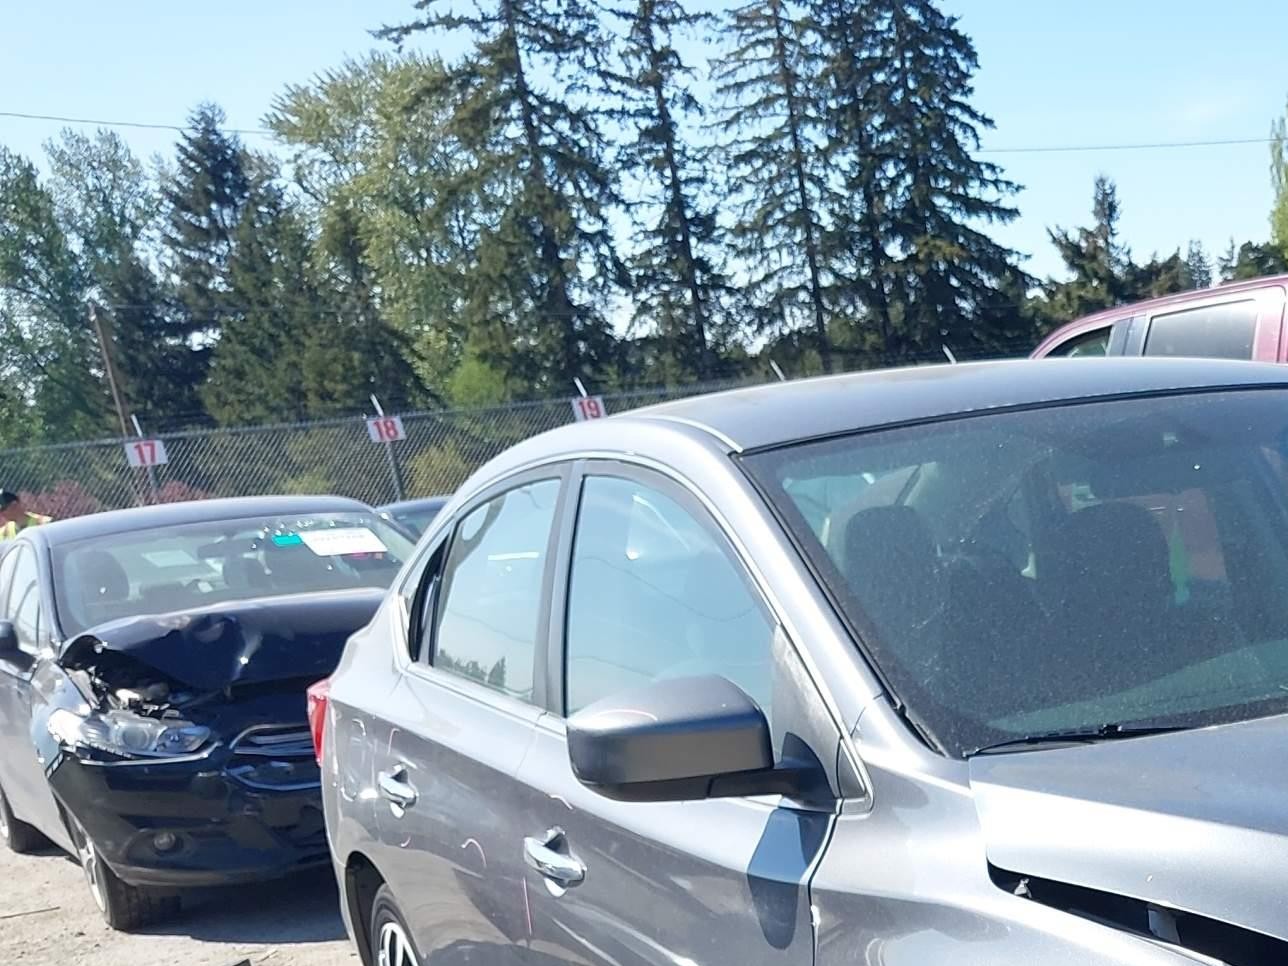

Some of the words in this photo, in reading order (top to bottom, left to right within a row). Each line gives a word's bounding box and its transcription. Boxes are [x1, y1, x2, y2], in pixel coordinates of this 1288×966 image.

[578, 399, 602, 420] 19
[373, 419, 399, 440] 18
[134, 440, 156, 464] 17
